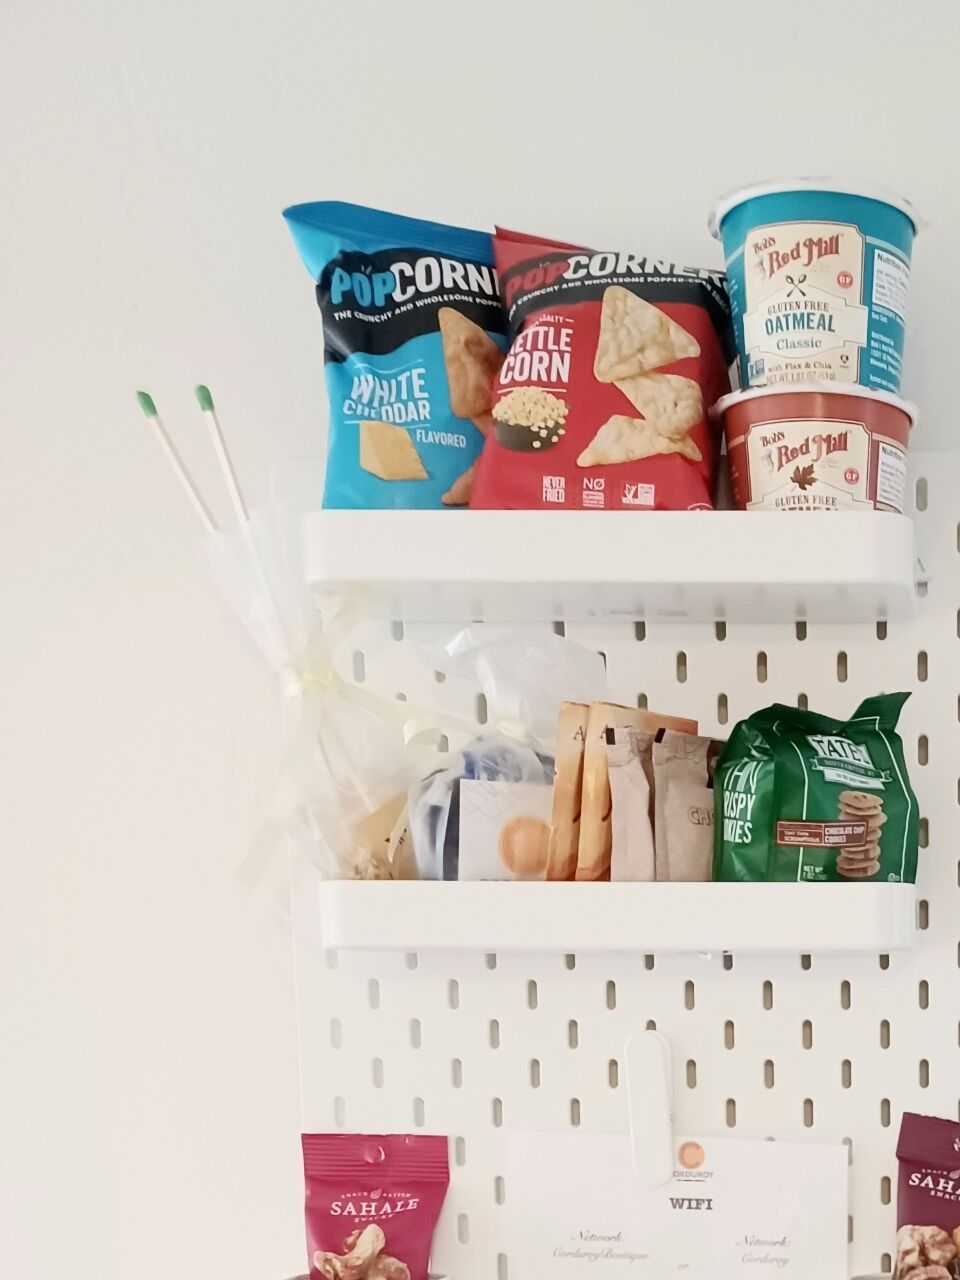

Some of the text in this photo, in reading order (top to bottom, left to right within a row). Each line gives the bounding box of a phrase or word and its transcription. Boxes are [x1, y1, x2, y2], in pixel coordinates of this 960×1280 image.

[767, 233, 840, 280] Red Mill
[517, 284, 560, 306] CRUNCHY
[561, 280, 582, 291] AND
[584, 275, 645, 287] WHOLESOME
[333, 293, 474, 323] THE CRUNCHY AND WHOLESOME
[767, 300, 829, 316] GLUTEN FREE
[765, 312, 836, 336] OATMEAL
[776, 337, 822, 351] Classic
[500, 350, 571, 385] CORN
[785, 362, 802, 370] Flax
[351, 367, 429, 404] WHITE
[342, 399, 430, 424] CHEDDAR
[416, 428, 467, 449] FLAVORED
[760, 431, 785, 447] Bob's
[776, 430, 848, 472] Red Mill
[542, 475, 566, 489] NEVER
[542, 488, 566, 503] FRIED
[775, 495, 838, 507] GLUTEN FREE
[330, 1198, 419, 1216] SAHALE
[669, 1197, 713, 1211] WIFI
